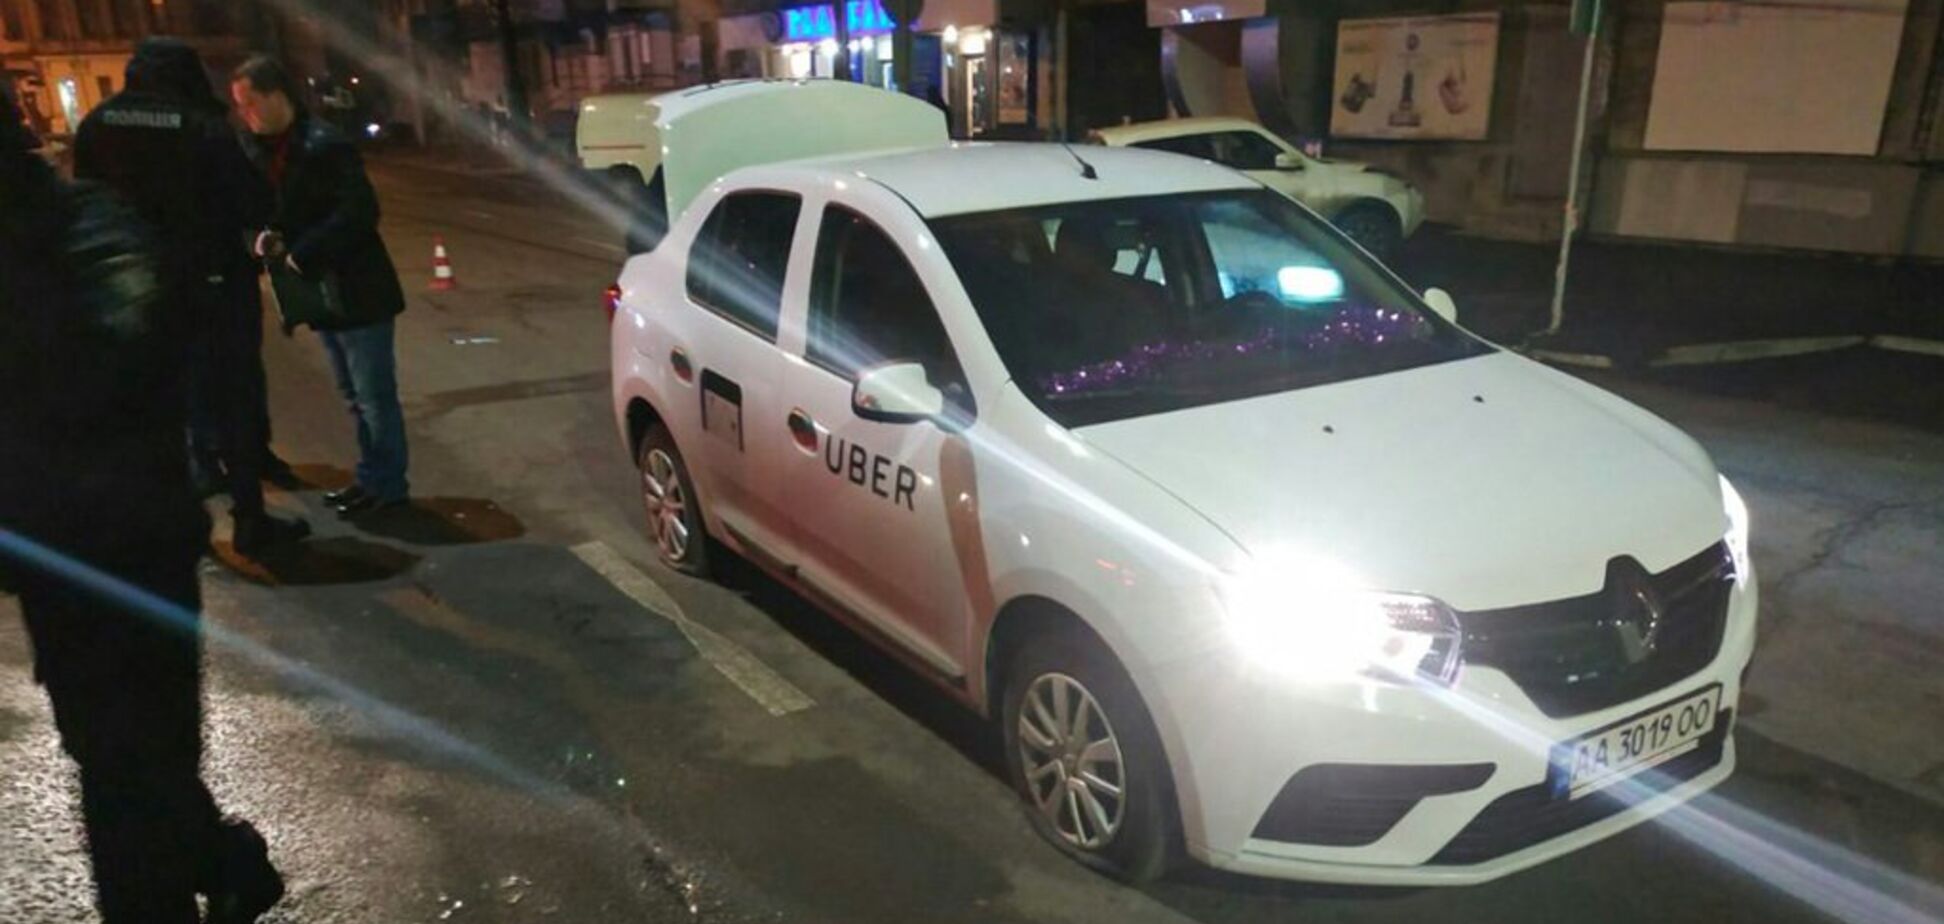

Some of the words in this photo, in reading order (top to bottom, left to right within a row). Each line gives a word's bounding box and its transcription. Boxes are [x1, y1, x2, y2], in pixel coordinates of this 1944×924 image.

[825, 434, 917, 511] UBER
[1572, 738, 1609, 780] AA
[1619, 713, 1673, 761] 3019
[1677, 698, 1711, 736] OO
